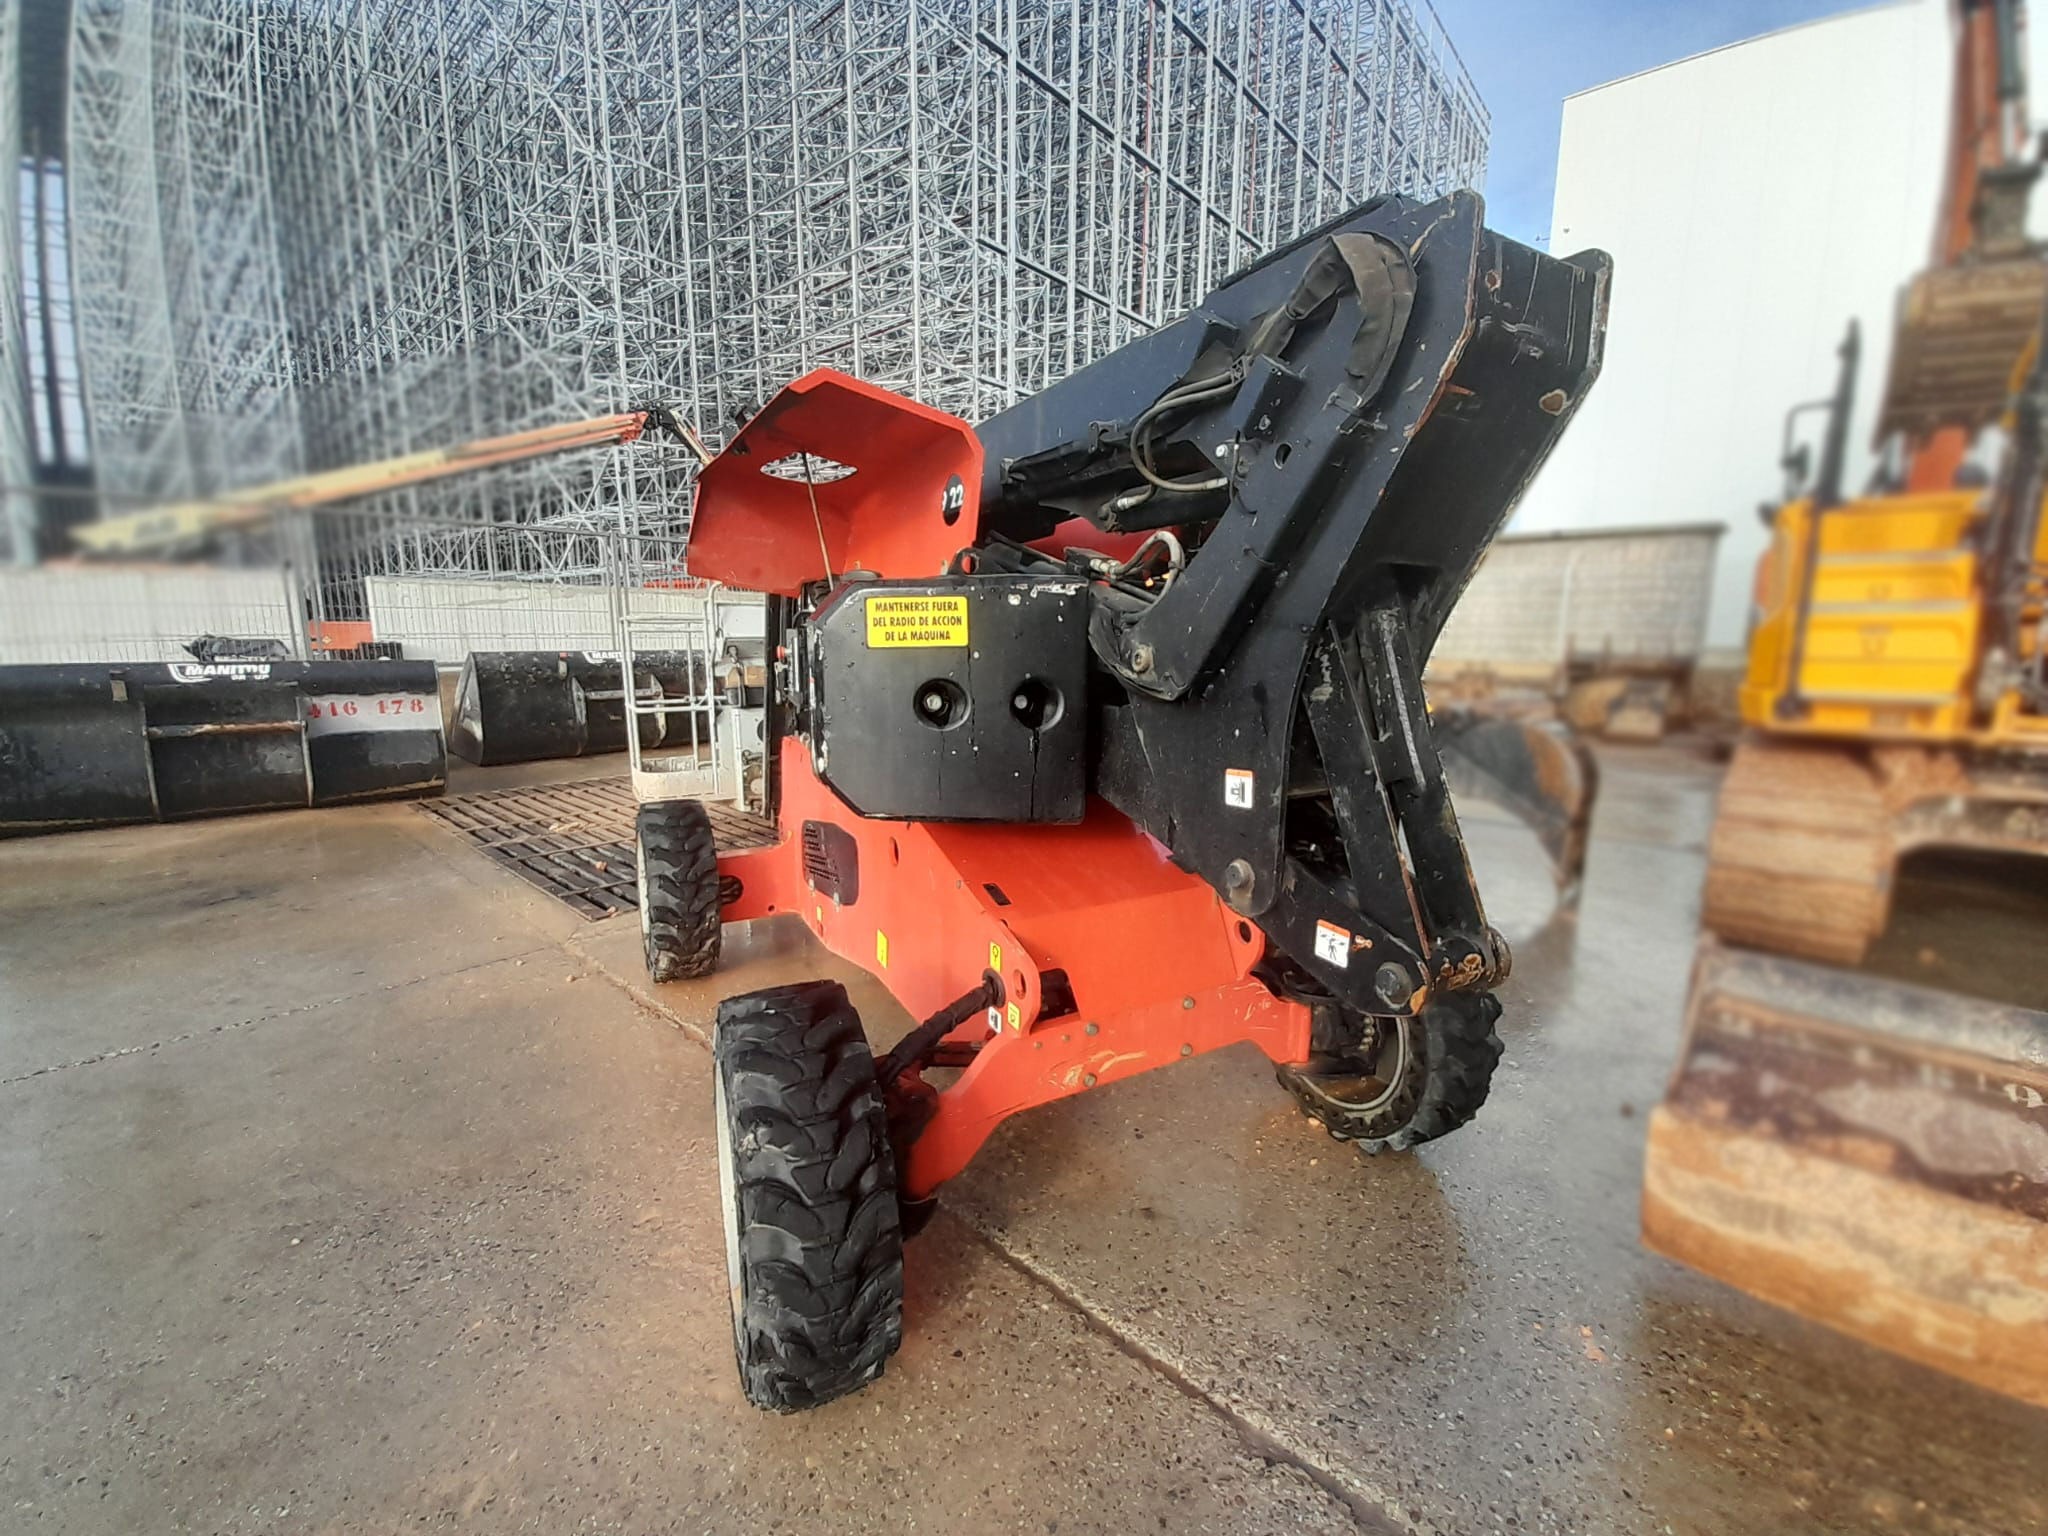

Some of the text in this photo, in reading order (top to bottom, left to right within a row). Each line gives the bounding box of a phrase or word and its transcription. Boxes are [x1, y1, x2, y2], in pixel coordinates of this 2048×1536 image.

[875, 601, 959, 613] MANTENERSE FUERA
[873, 615, 962, 627] DEL RADIO DE ACCION
[885, 630, 951, 641] DE LA MAQUINA
